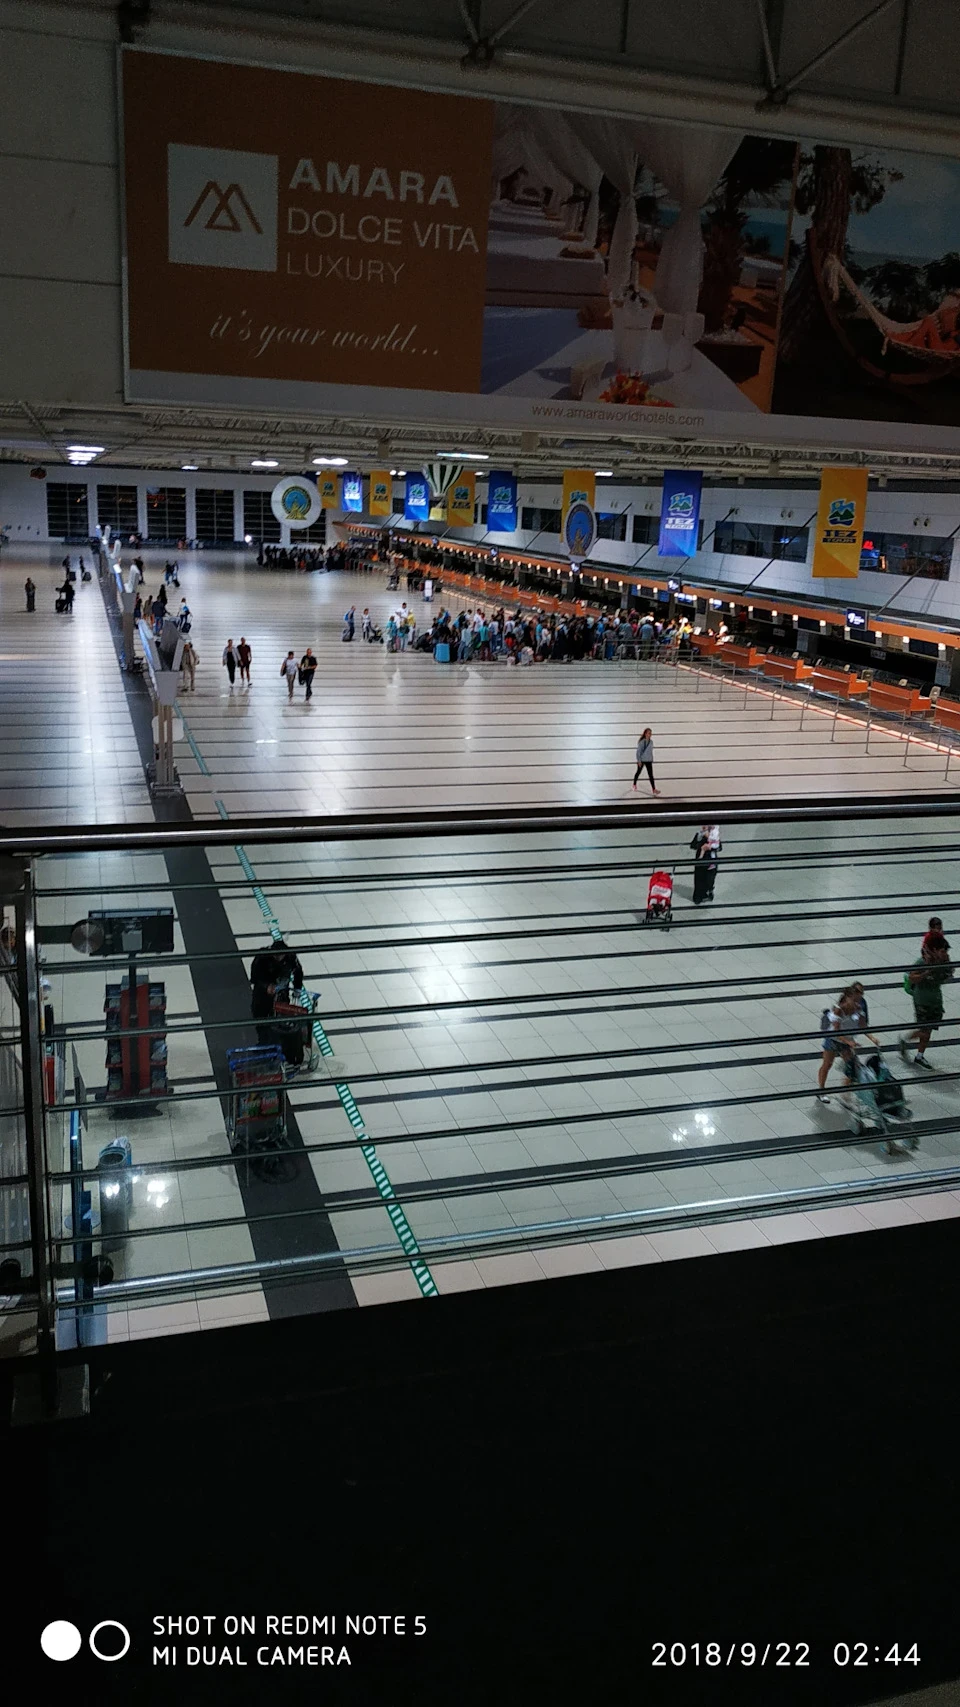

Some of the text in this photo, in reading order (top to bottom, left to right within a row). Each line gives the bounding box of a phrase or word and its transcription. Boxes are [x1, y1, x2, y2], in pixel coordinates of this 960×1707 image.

[288, 158, 460, 209] AMARA
[287, 206, 480, 253] DOLCE VITA
[286, 251, 406, 285] LUXURY
[208, 309, 253, 342] it's
[252, 325, 326, 359] your
[531, 405, 705, 426] www.amaraworldhotels.com
[824, 529, 858, 537] TEZ
